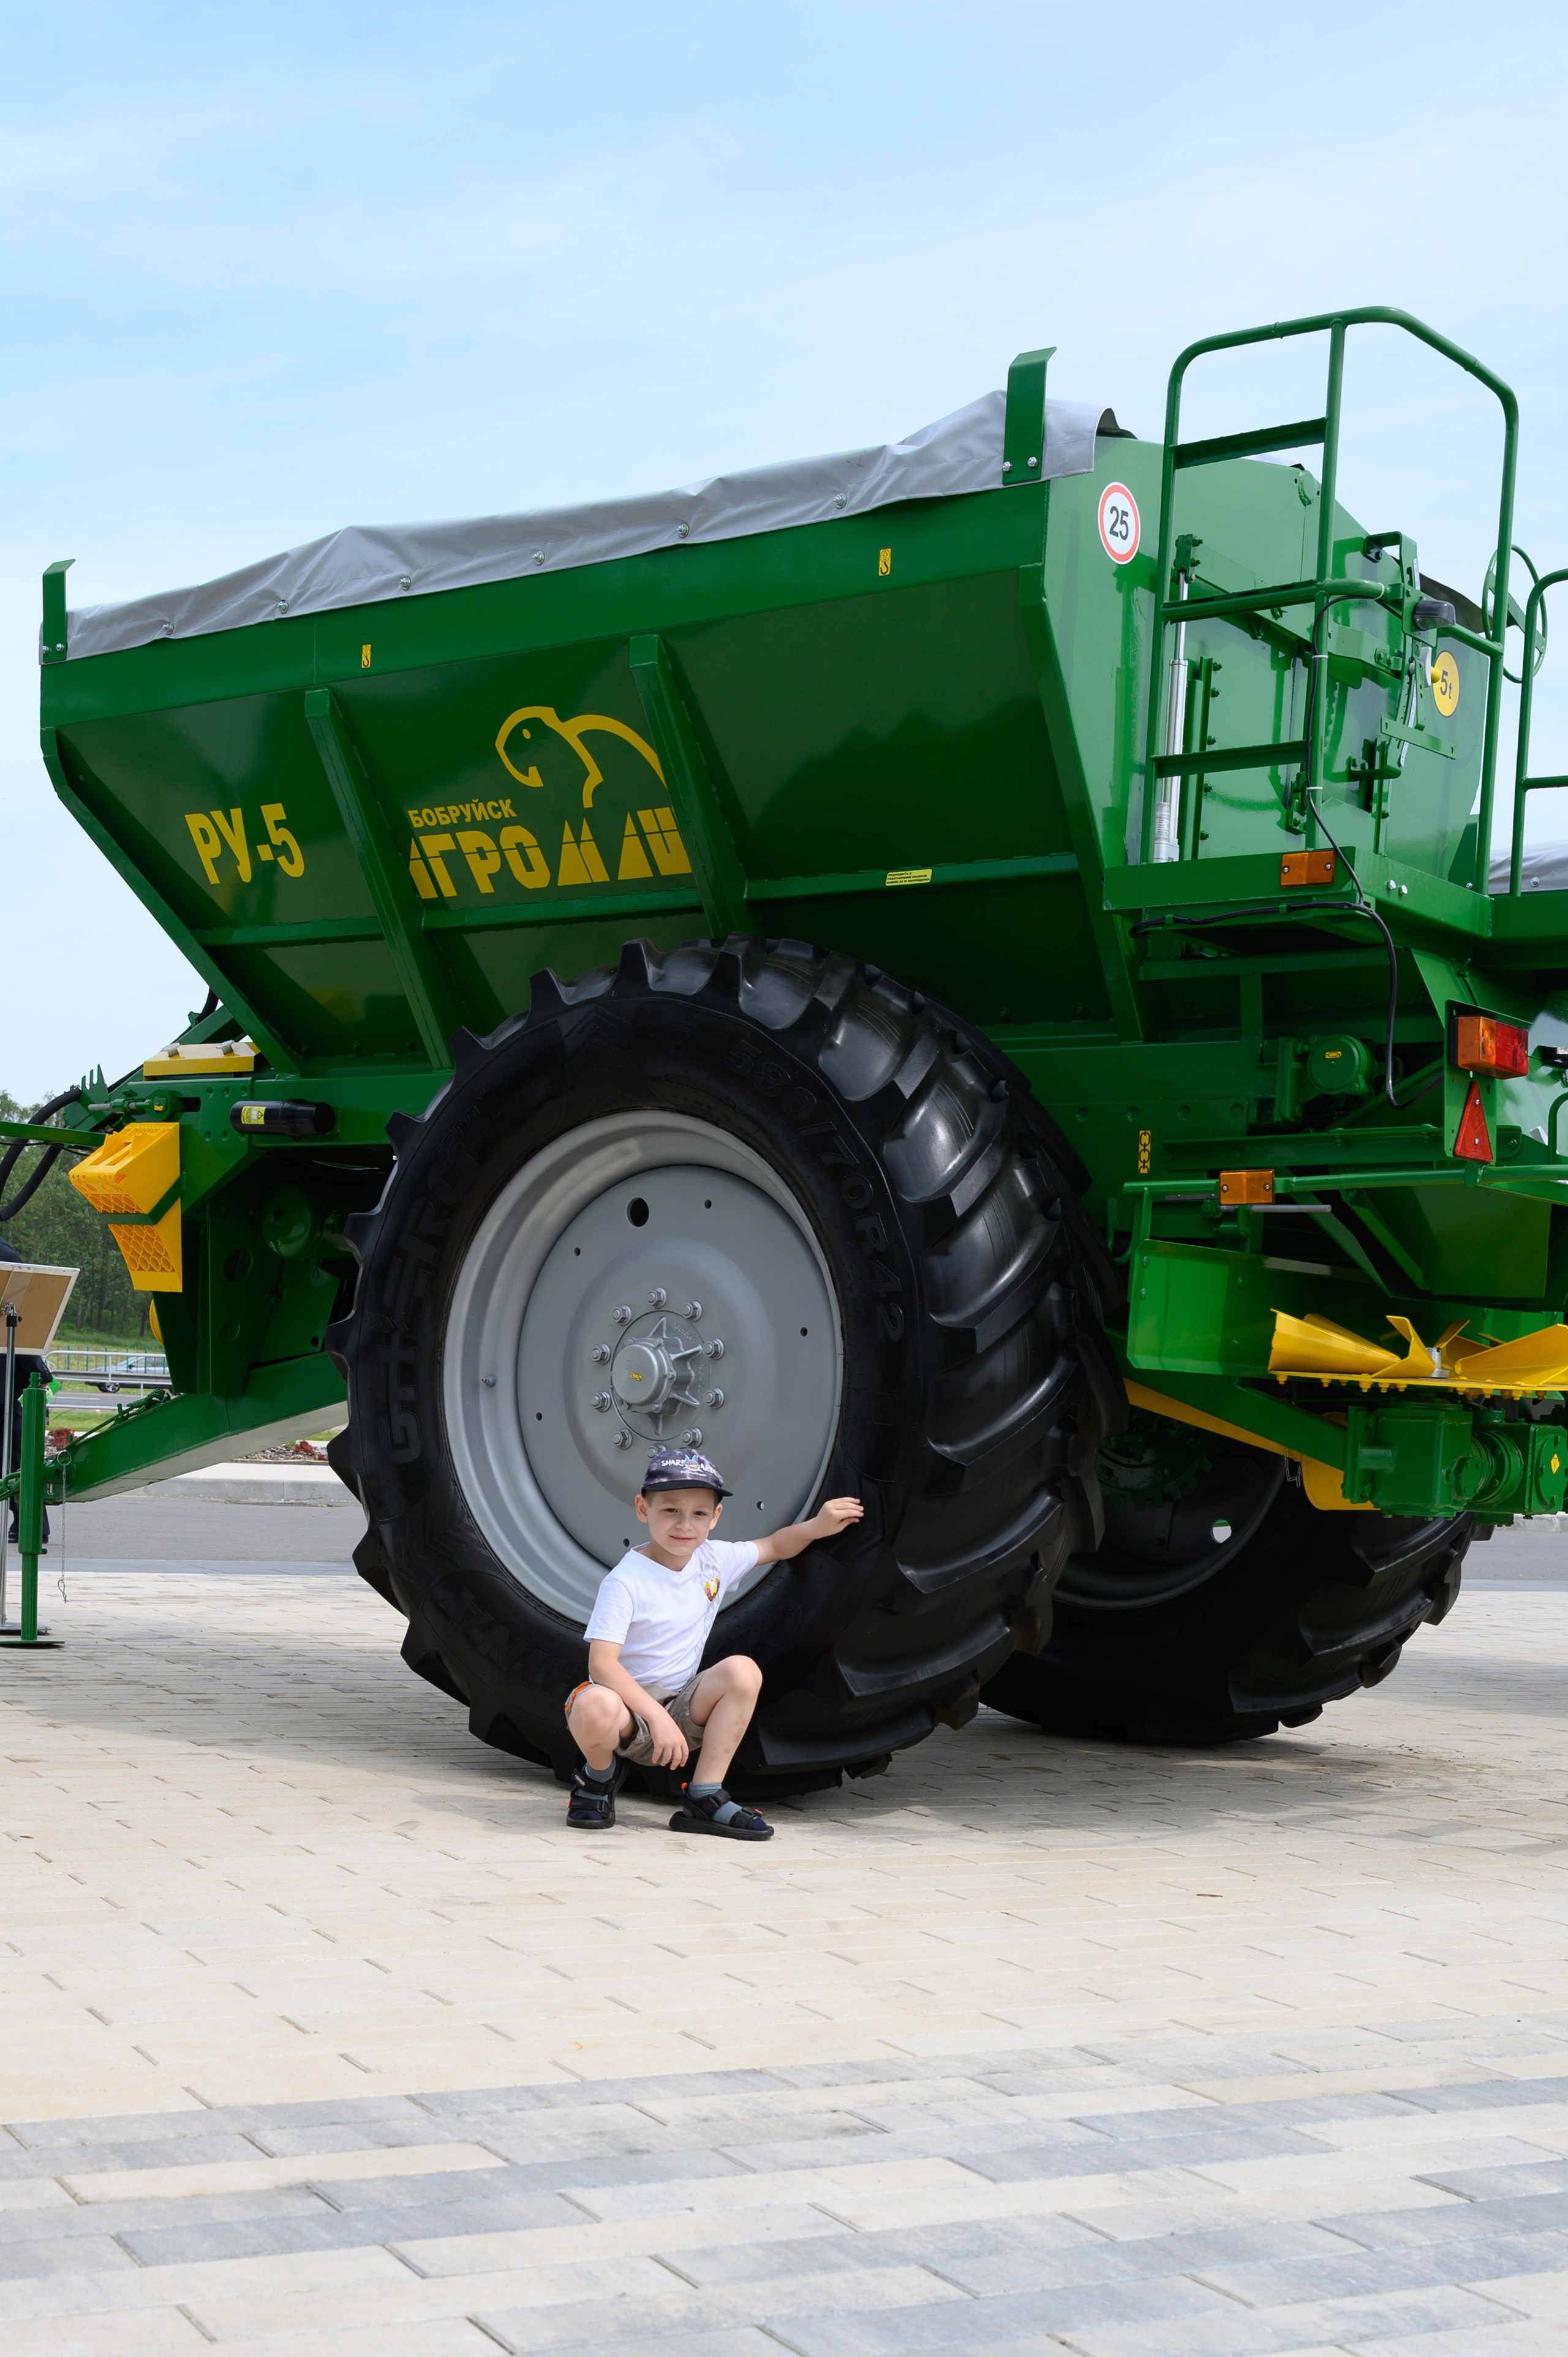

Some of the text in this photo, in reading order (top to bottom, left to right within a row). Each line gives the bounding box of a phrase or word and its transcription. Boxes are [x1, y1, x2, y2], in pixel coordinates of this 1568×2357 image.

[1109, 505, 1129, 540] 25
[407, 799, 517, 828] БОБРУЙСК
[184, 803, 304, 884] РУ-5
